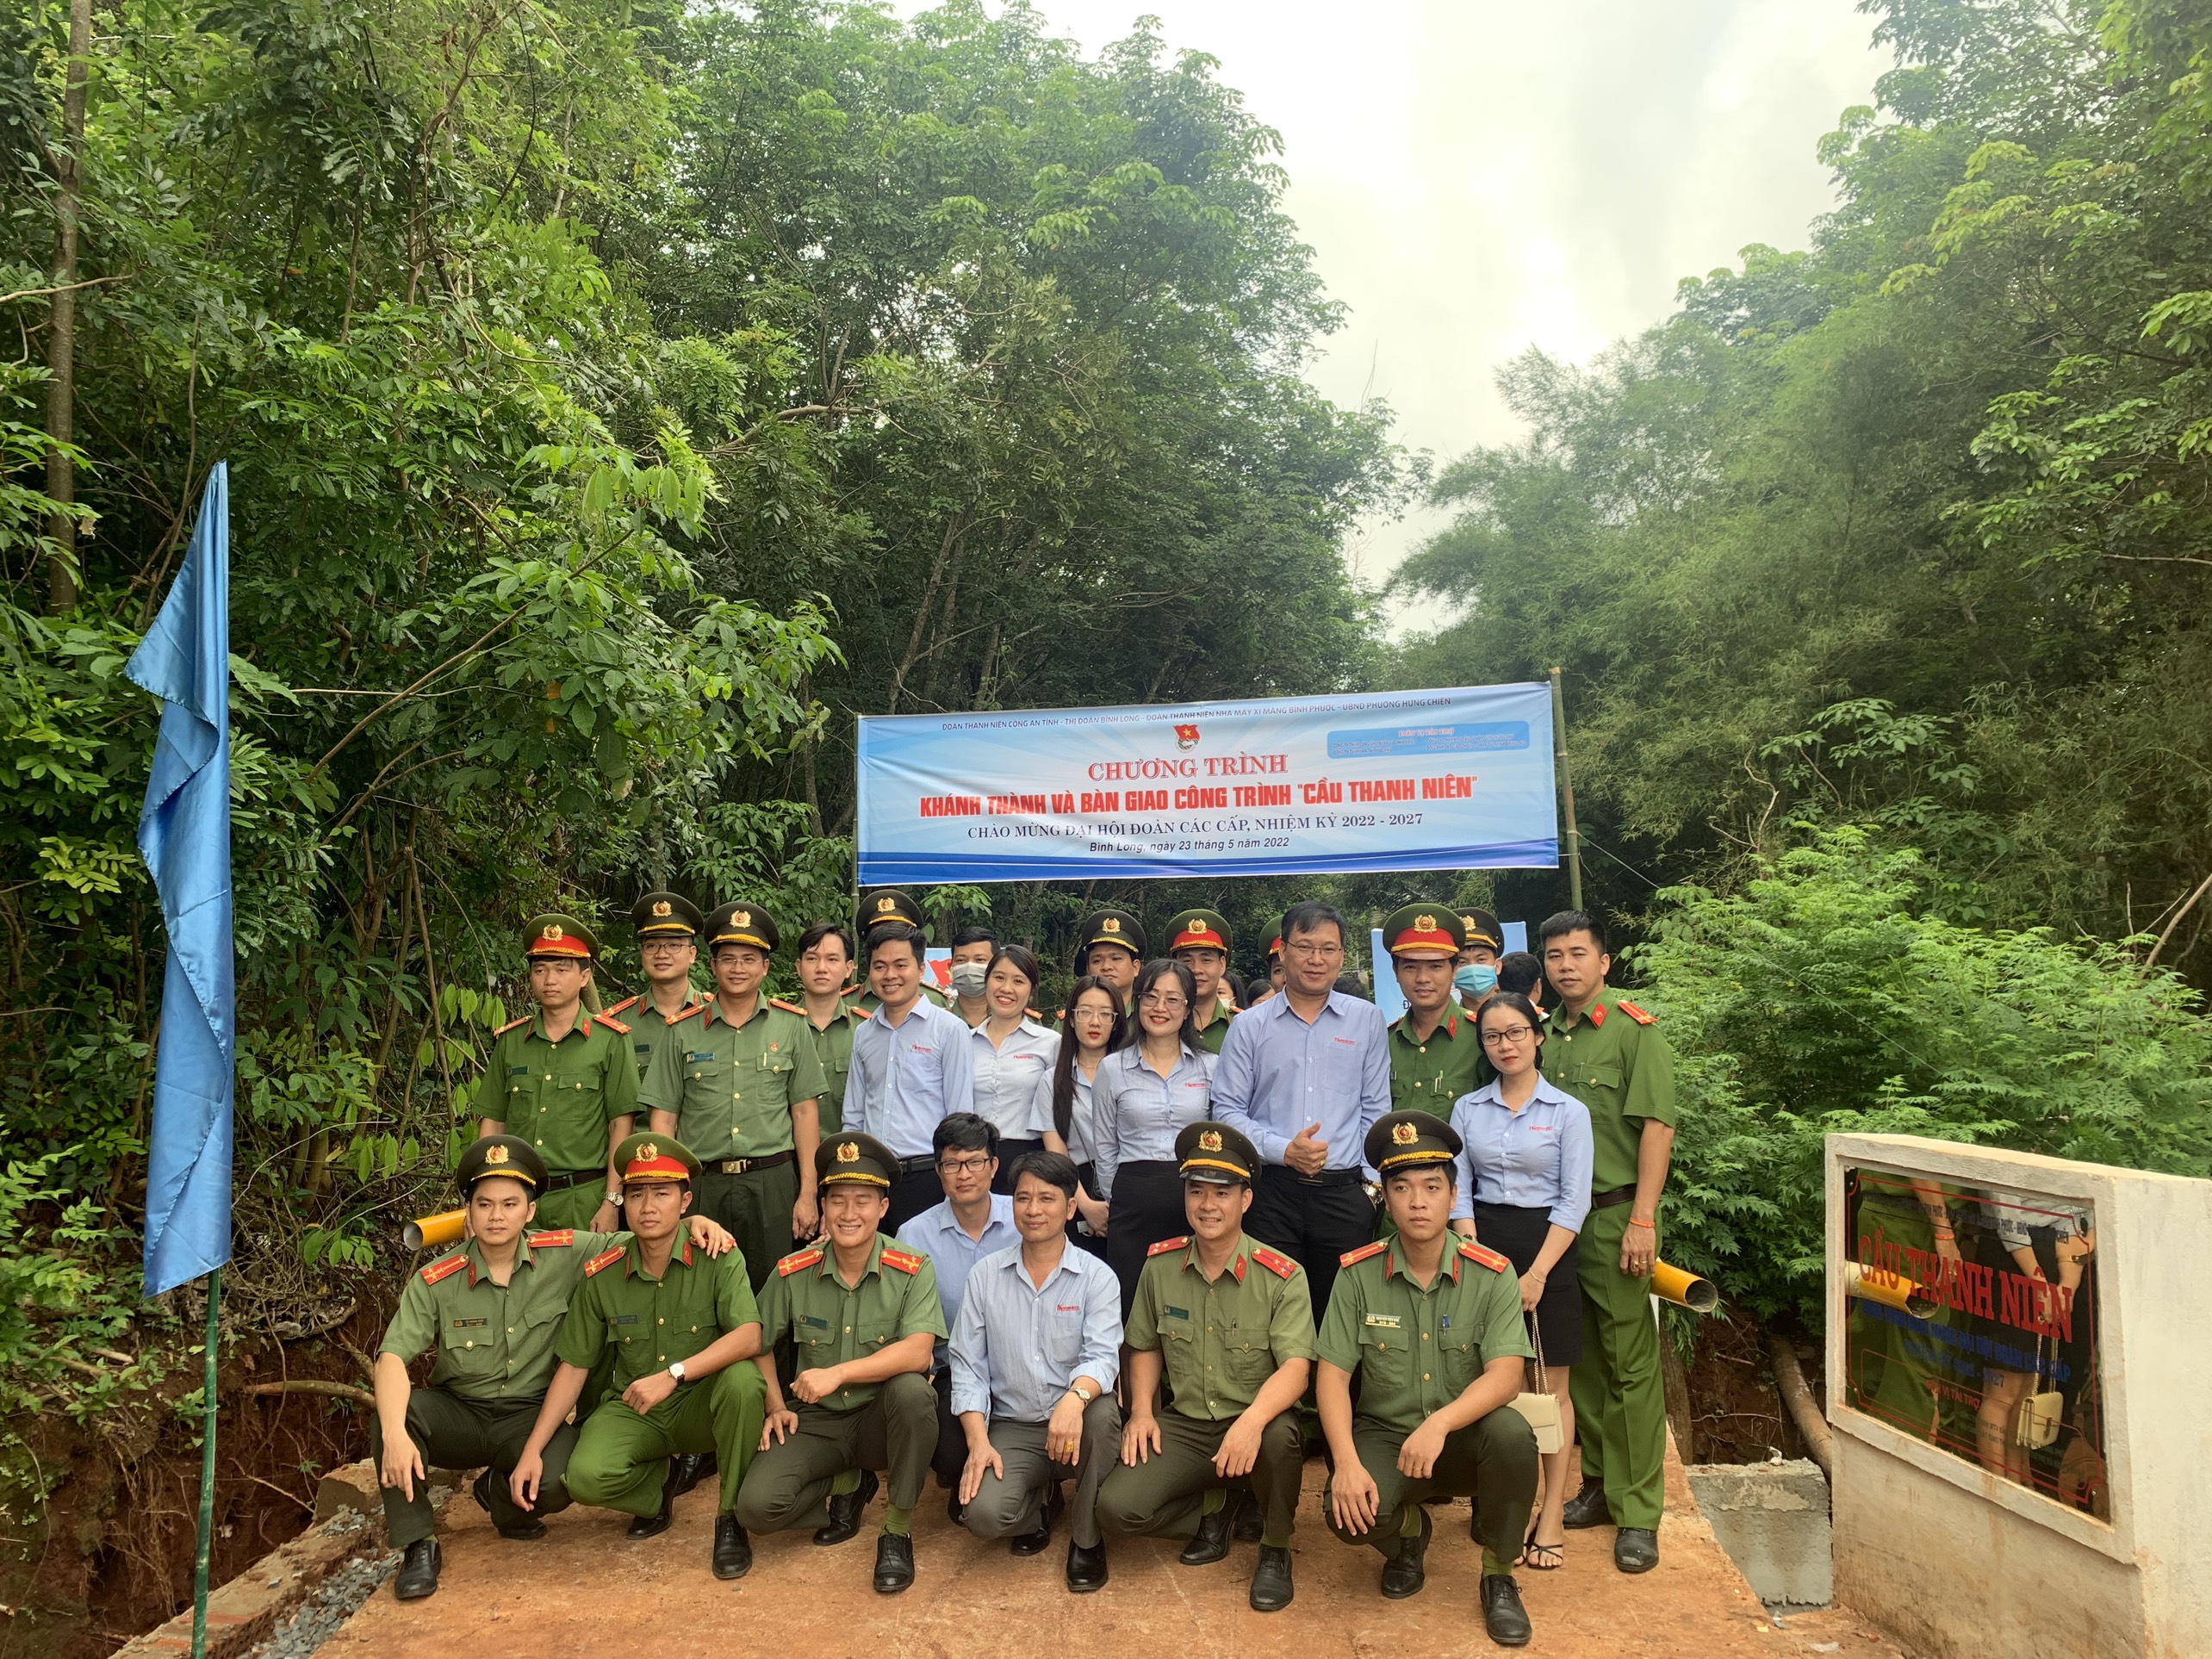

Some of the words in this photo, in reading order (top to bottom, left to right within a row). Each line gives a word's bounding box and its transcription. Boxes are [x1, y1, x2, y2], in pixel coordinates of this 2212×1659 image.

[965, 721, 989, 730] THANH
[1120, 714, 1140, 723] LONG
[1170, 711, 1195, 720] THANH
[1342, 702, 1365, 711] UBND
[1088, 757, 1198, 781] CHƯƠNG
[1203, 751, 1289, 776] TRÌNH
[920, 792, 981, 817] KHÁNH
[986, 791, 1047, 815] THÀNH
[1051, 790, 1076, 814] VÀ
[1080, 788, 1119, 813] BÀN
[1125, 790, 1169, 811] GIAO
[1174, 785, 1227, 810] CÔNG
[1233, 781, 1291, 807] TRÌNH
[1348, 779, 1416, 803] THANH
[967, 823, 1010, 839] CHÀO
[1015, 822, 1060, 837] MỪNG
[1065, 824, 1092, 838] ĐẠI
[1097, 820, 1127, 838] HỘI
[1129, 819, 1175, 836] ĐOÀN
[1179, 817, 1212, 834] CÁC
[1216, 814, 1250, 834] CẤP,
[1255, 814, 1310, 832] NHIỆM
[1315, 812, 1337, 829] KỲ
[1342, 815, 1376, 828] 2022
[1389, 813, 1423, 825] 2027
[1090, 841, 1114, 852] Bình
[1116, 842, 1146, 854] Long,
[1149, 841, 1176, 854] ngày
[1178, 841, 1191, 850] 23
[1194, 838, 1225, 852] tháng
[1227, 839, 1234, 848] 5
[1237, 837, 1261, 848] năm
[1264, 837, 1289, 848] 2022
[1905, 1246, 1994, 1320] THANH
[1999, 1266, 2073, 1343] NIÊN
